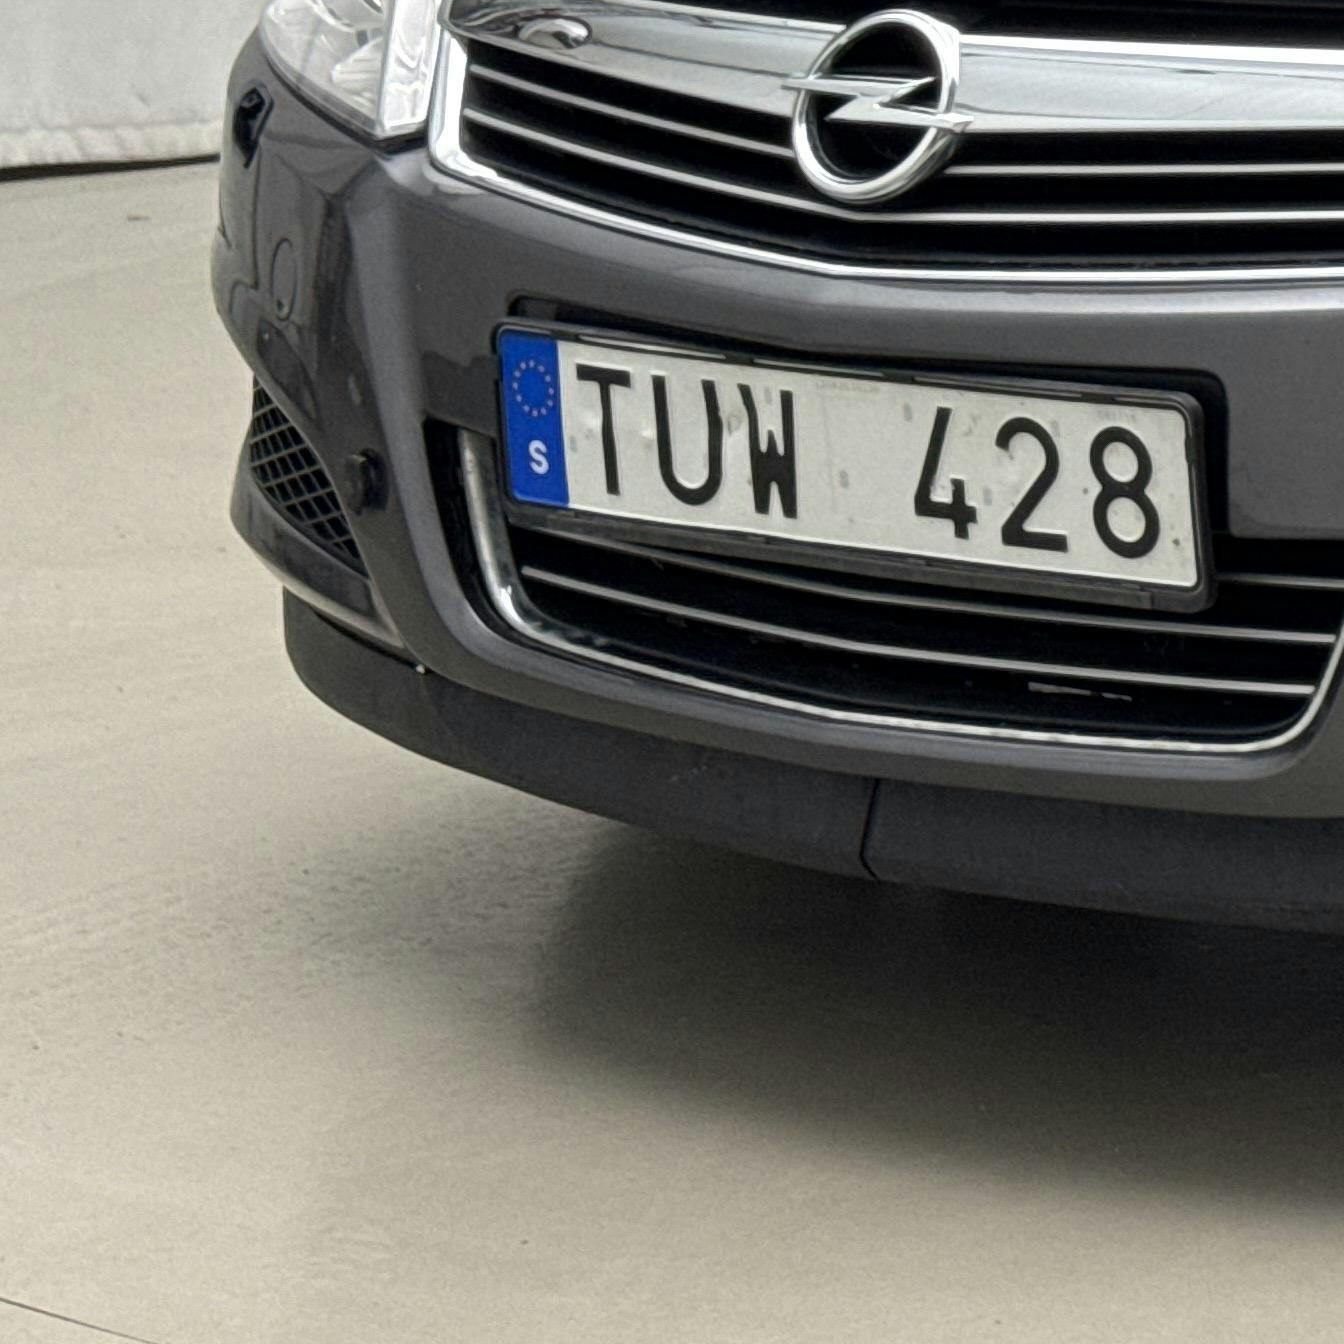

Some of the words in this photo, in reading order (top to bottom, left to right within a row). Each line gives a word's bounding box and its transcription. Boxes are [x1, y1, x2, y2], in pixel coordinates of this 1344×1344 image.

[528, 439, 549, 475] S
[576, 363, 798, 519] TUW
[914, 407, 1160, 559] 428
